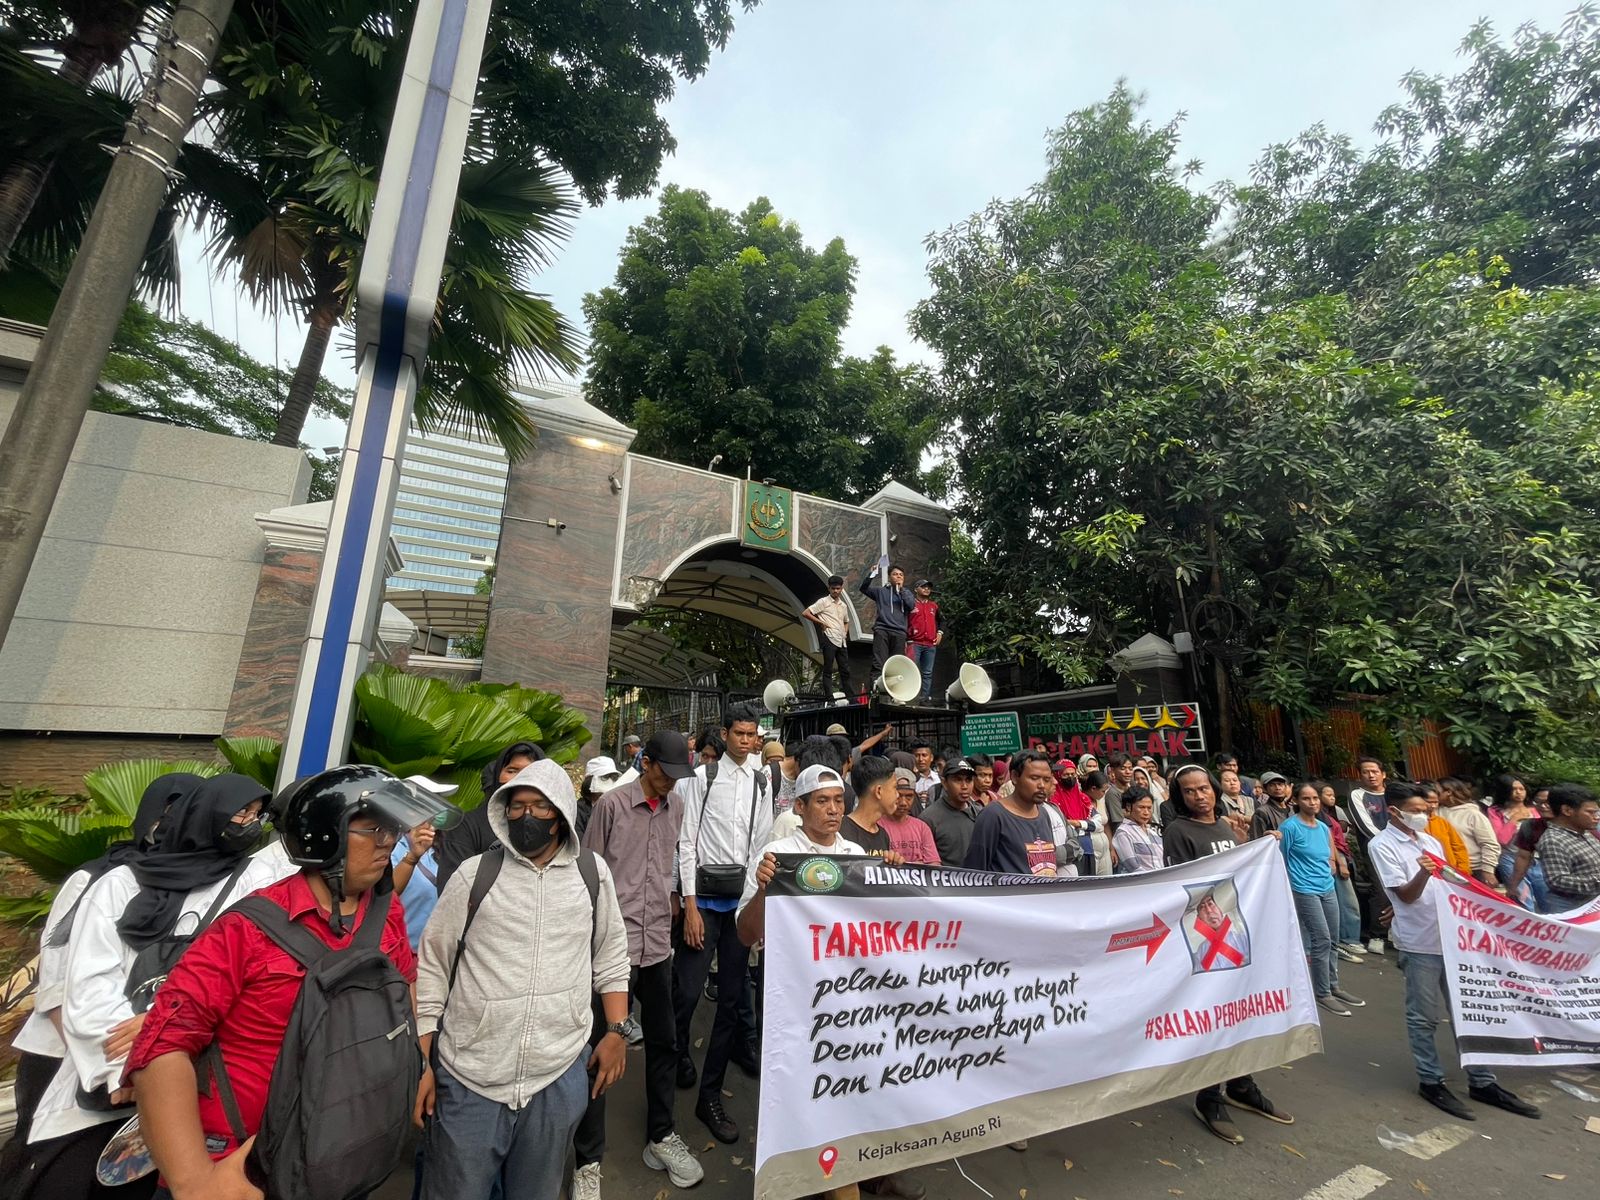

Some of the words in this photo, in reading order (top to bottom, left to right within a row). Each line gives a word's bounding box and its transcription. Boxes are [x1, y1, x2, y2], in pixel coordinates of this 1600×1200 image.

[864, 866, 928, 887] ALIAKSI
[931, 868, 995, 888] PEMUDA
[809, 920, 963, 962] TANGKAP.!!
[812, 967, 909, 1008] pelaku
[1458, 963, 1474, 973] Di
[810, 993, 951, 1041] perampok
[956, 989, 1009, 1024] uang
[1014, 972, 1080, 1007] rakyat
[1144, 1009, 1211, 1041] #SALAM
[1461, 1000, 1499, 1012] Kasus
[1462, 1013, 1508, 1025] Miliyar
[813, 1032, 887, 1064] Demi
[895, 1014, 1045, 1050] Memperkaya
[1053, 1000, 1088, 1027] Diri
[812, 1074, 871, 1100] Dan
[879, 1045, 1007, 1088] Kelompok
[858, 1137, 938, 1162] Kejaksaan
[942, 1122, 986, 1144] Agung
[988, 1115, 1001, 1131] Ri
